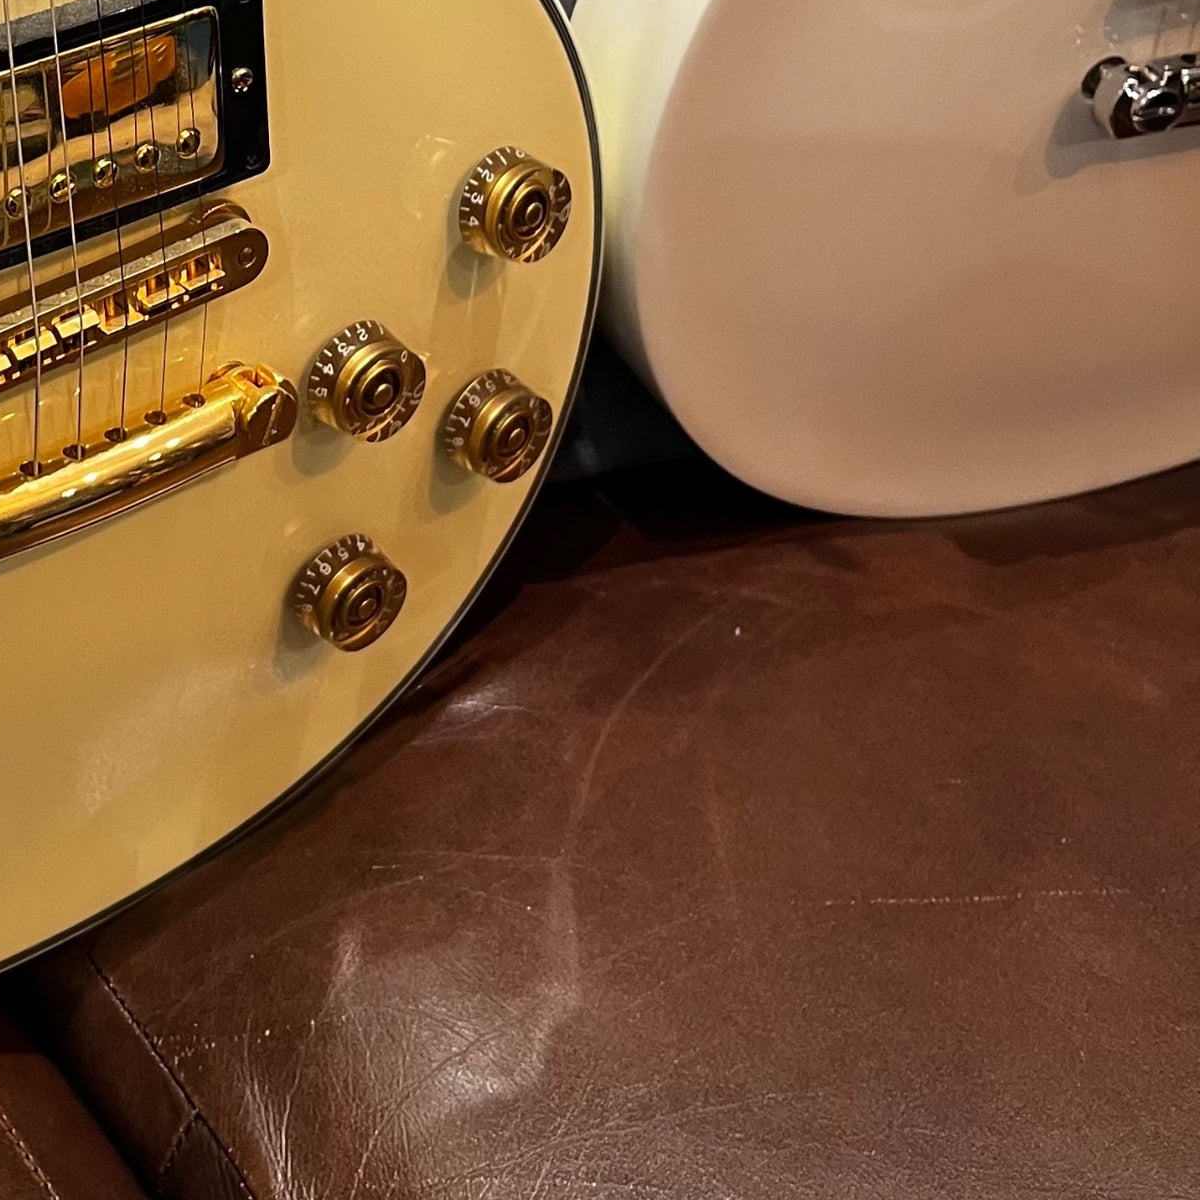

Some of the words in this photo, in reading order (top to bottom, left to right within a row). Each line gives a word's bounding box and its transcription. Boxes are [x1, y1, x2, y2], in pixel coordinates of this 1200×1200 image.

[481, 169, 495, 183] 2
[470, 192, 484, 206] 3
[468, 216, 479, 227] 4
[356, 328, 368, 341] 2
[337, 342, 350, 356] 3
[321, 363, 334, 375] 4
[314, 387, 328, 398] 5
[485, 380, 496, 392] 5
[468, 395, 481, 408] 6
[458, 417, 471, 428] 7
[337, 547, 349, 560] 5
[319, 562, 332, 575] 6
[308, 584, 321, 595] 7
